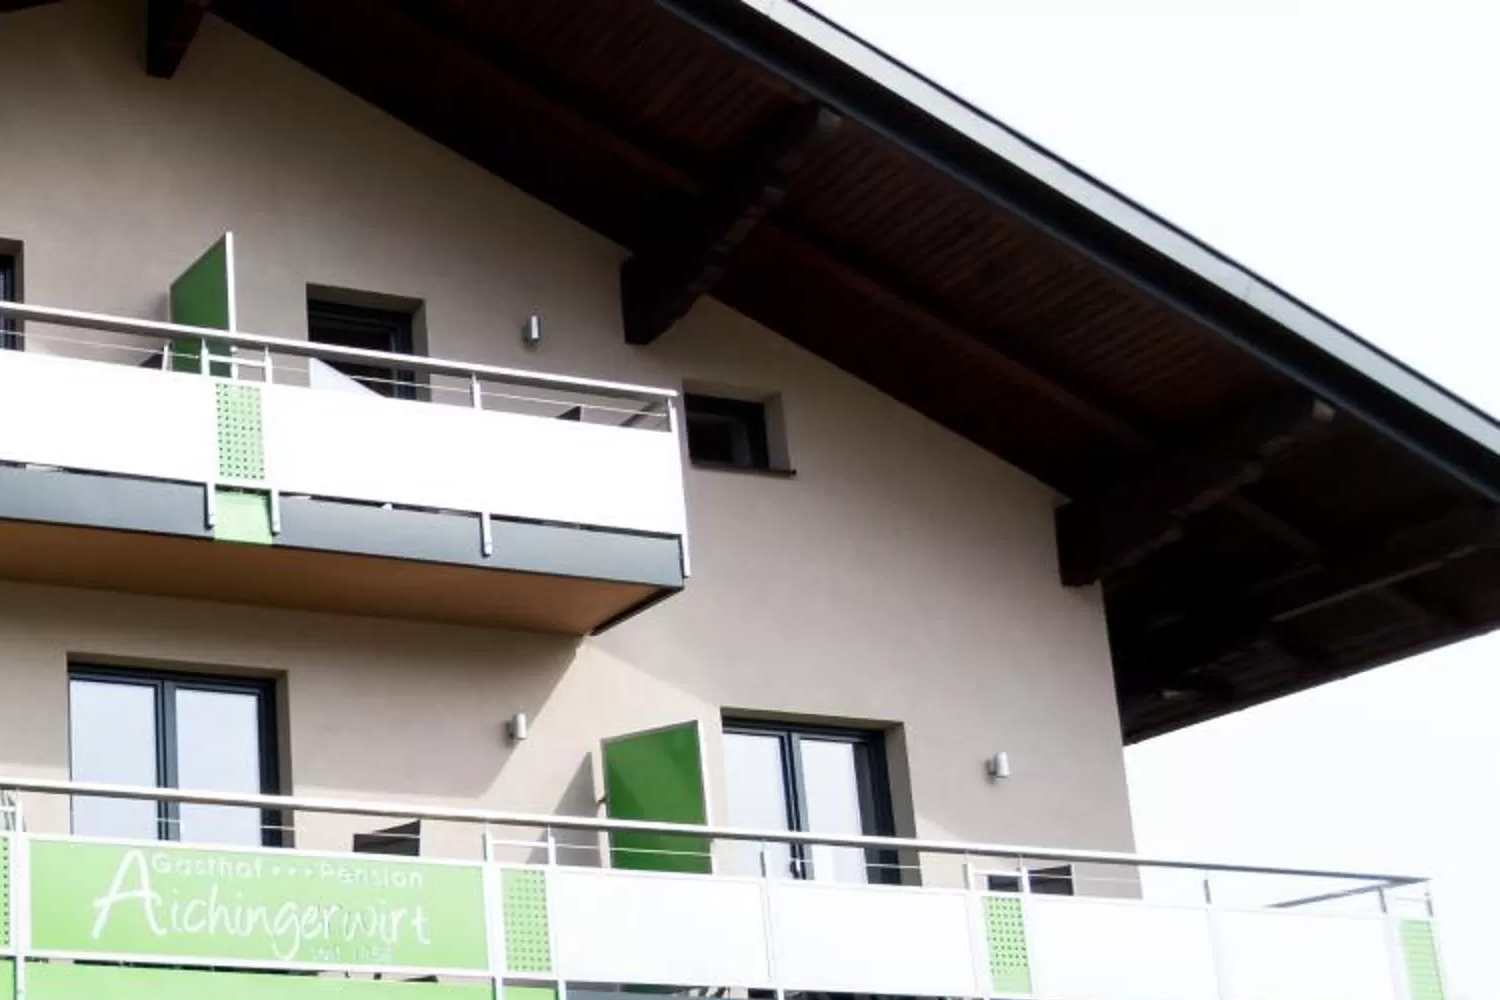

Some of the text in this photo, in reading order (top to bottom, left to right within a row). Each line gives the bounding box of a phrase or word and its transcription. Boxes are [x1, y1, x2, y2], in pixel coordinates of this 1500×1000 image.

[92, 849, 431, 959] Aichingerwirt
[151, 853, 423, 889] Gasthof Pension
